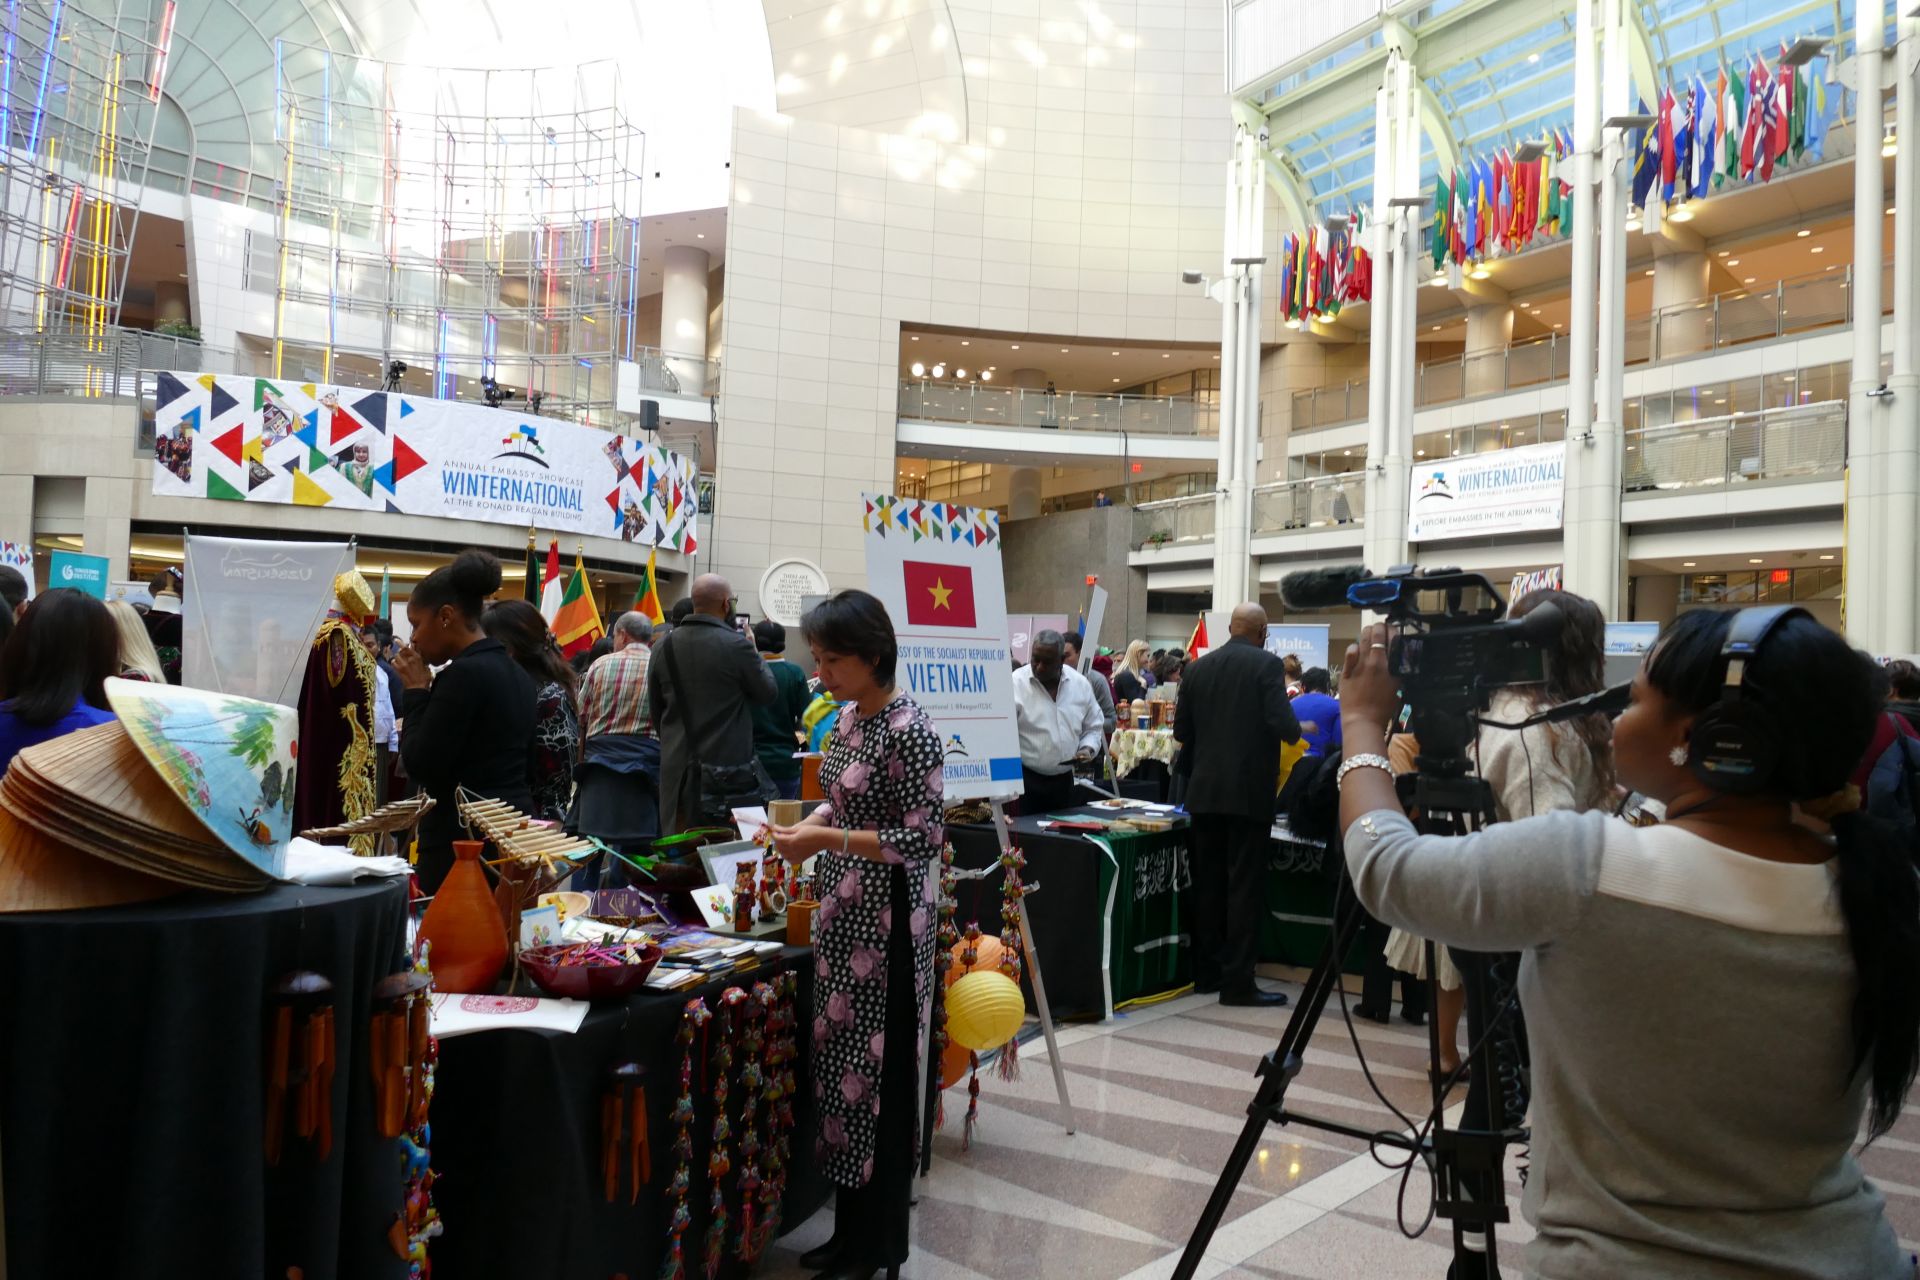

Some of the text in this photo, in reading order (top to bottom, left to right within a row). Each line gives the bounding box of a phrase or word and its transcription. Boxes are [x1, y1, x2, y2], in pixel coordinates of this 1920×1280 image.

[443, 460, 584, 488] ANNUAL EMBASSY SHOWCASE
[1458, 461, 1564, 492] WINTERNATIONAL
[442, 469, 584, 512] WINTERNATIONAL
[443, 497, 582, 521] AT THE RONALD REAGAN BUILDING
[1421, 506, 1552, 527] EXPLORE EMBASSIES IN THE ATRIUM HALL
[912, 646, 921, 659] OF
[923, 646, 936, 659] THE
[937, 647, 967, 660] SOCIALIST
[969, 648, 996, 661] REPUBLIC
[997, 649, 1006, 661] OF
[1275, 636, 1313, 651] Malta.
[906, 663, 988, 694] VIETNAM
[942, 763, 990, 780] ERNATIONAL
